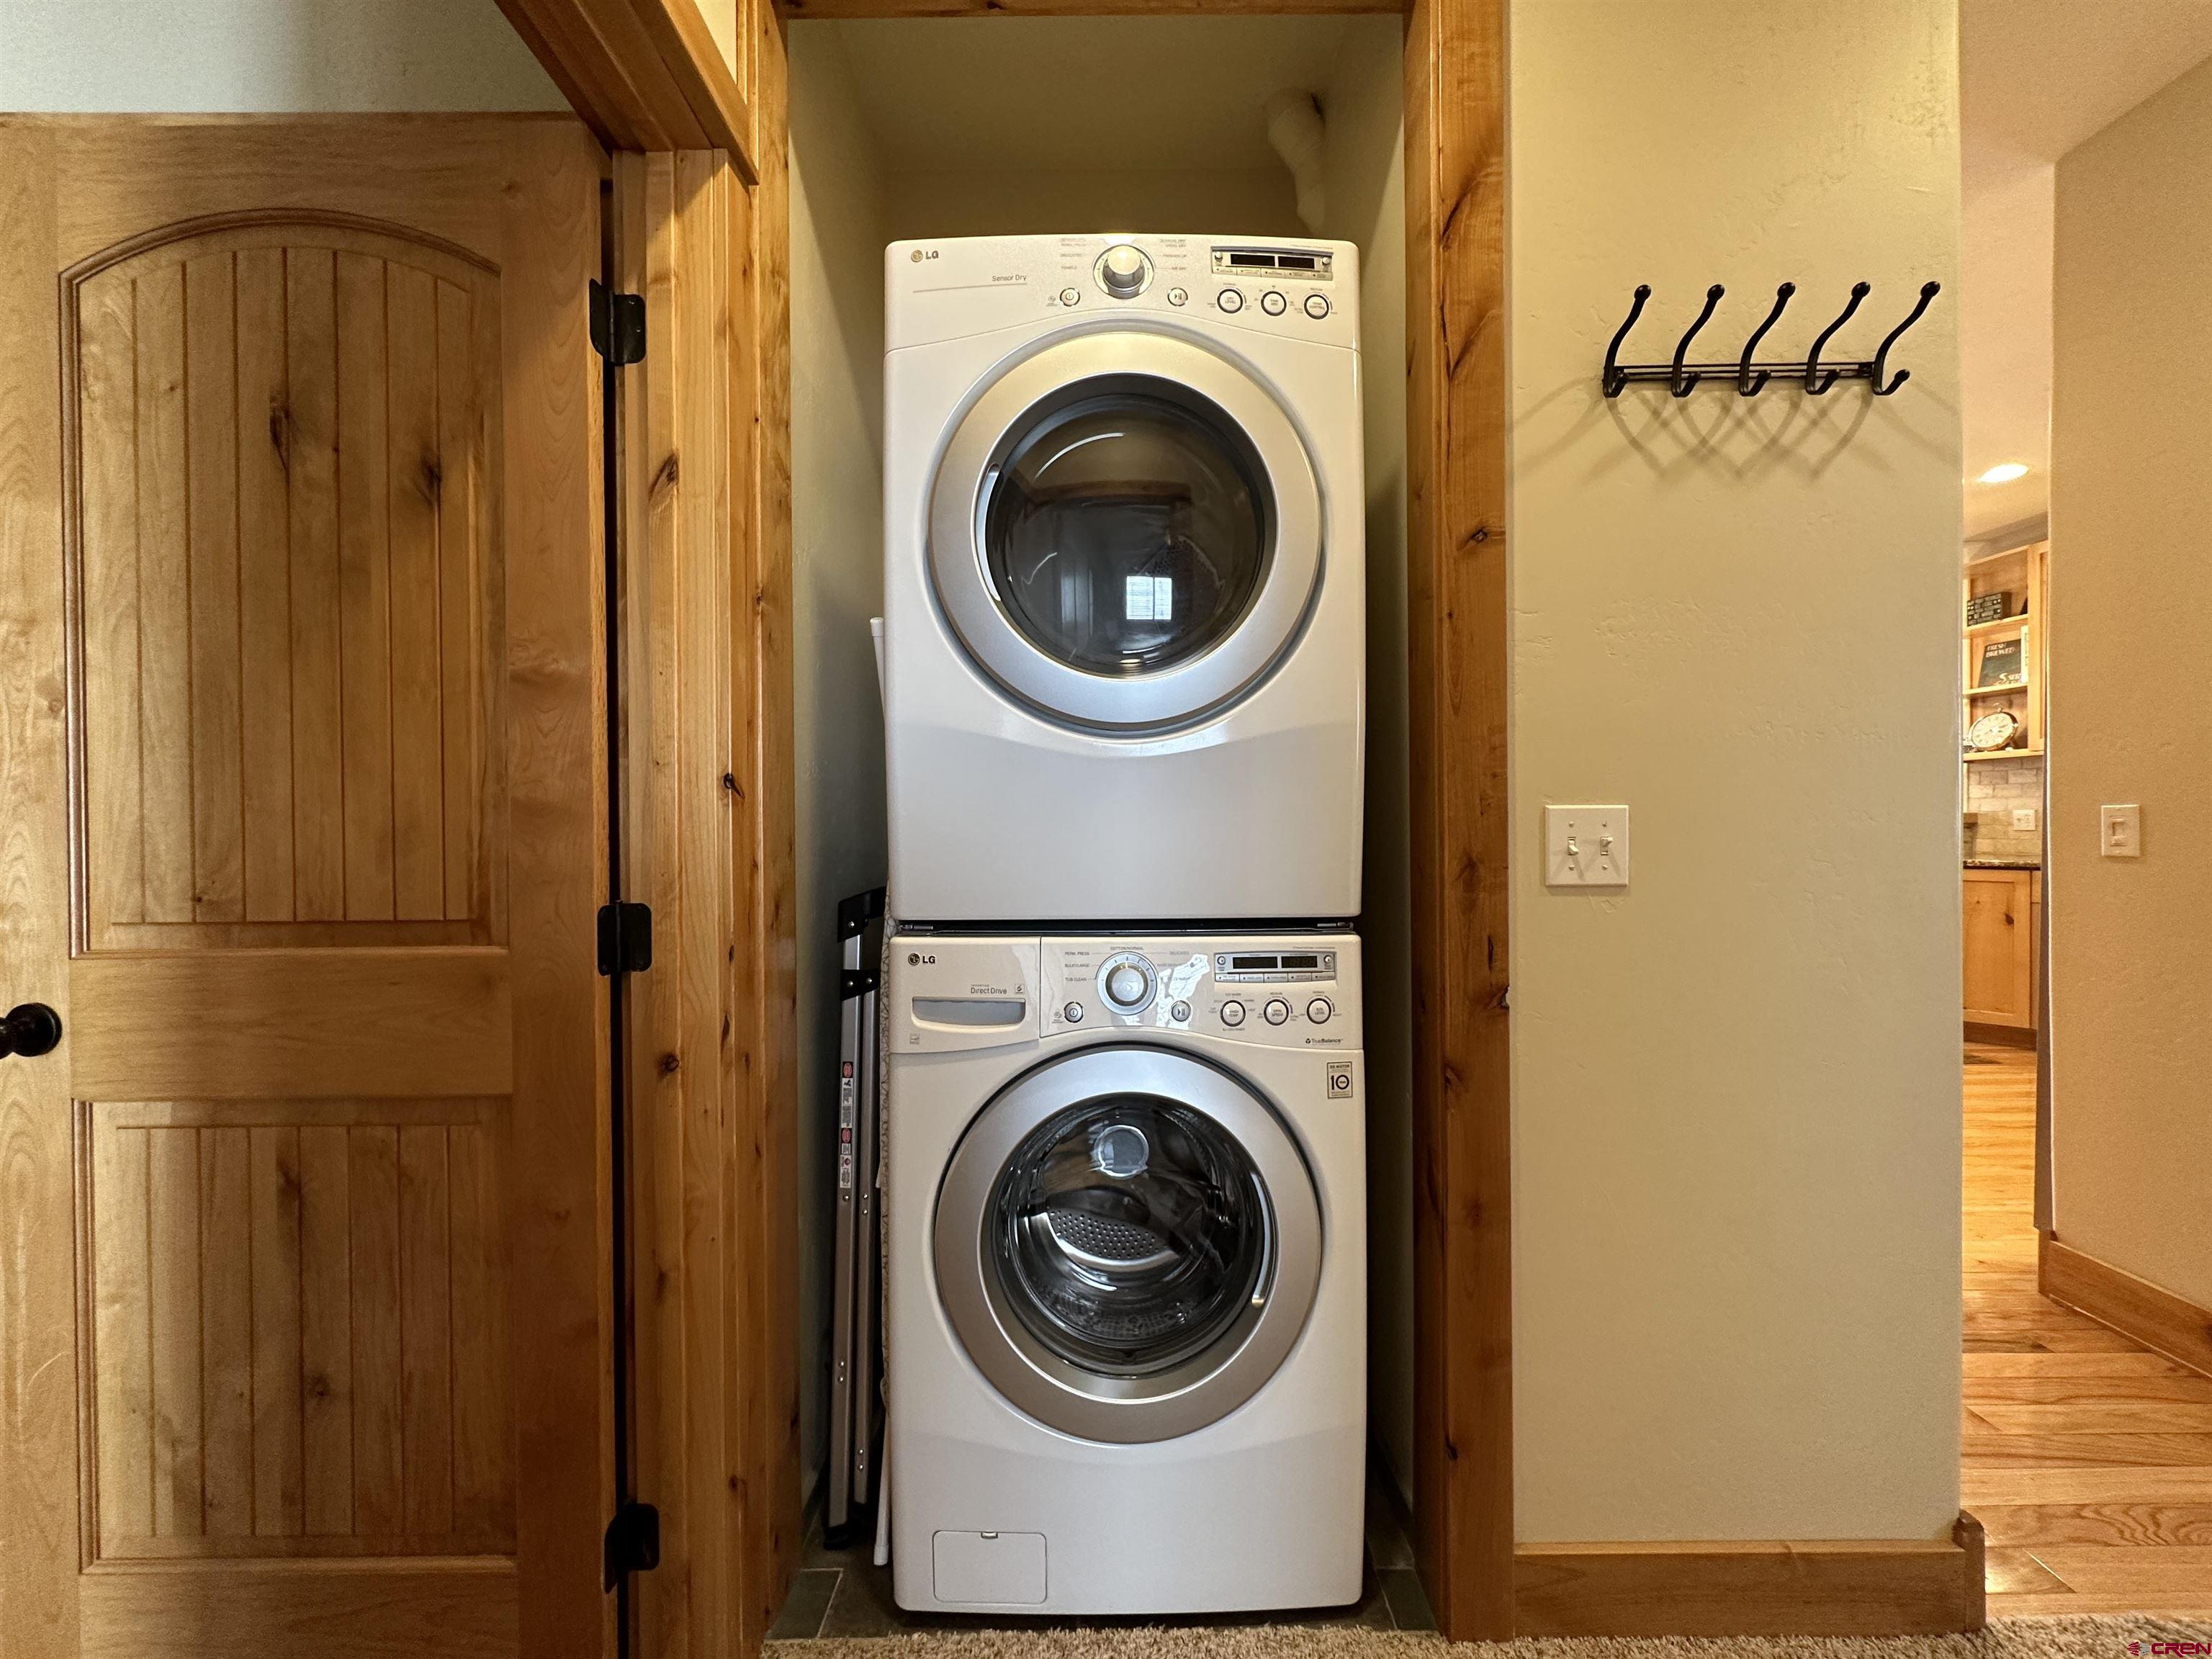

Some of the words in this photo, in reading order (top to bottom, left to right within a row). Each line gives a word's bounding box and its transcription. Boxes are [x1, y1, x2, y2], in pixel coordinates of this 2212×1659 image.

[925, 251, 939, 259] LG
[922, 955, 936, 964] LG
[1331, 1074, 1350, 1090] 10
